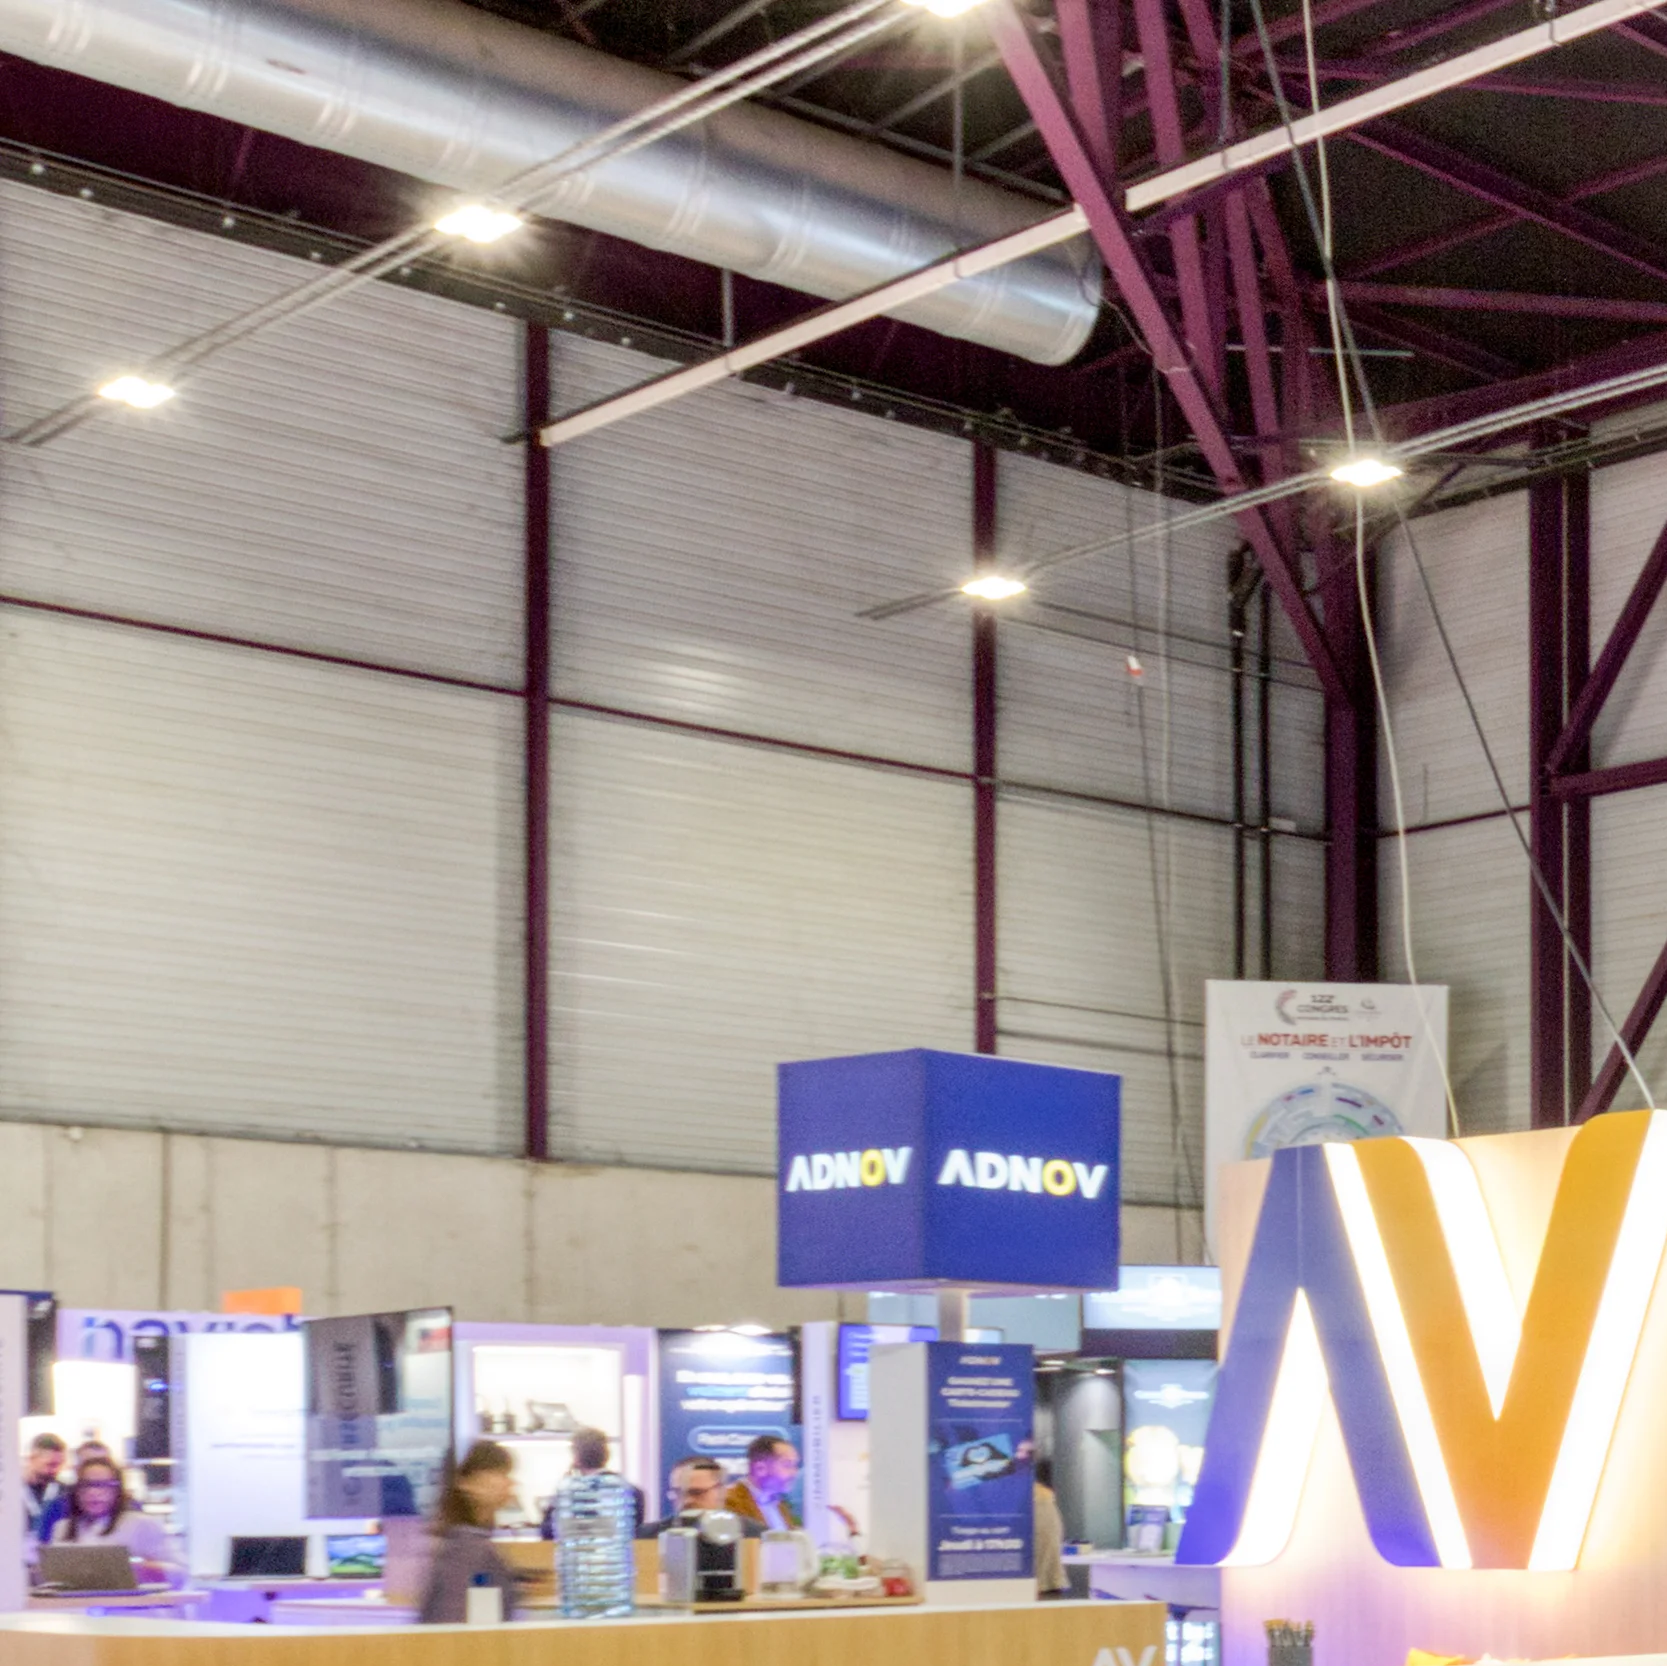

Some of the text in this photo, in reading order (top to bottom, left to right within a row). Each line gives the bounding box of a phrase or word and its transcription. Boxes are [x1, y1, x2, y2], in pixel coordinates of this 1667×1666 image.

[1257, 1033, 1329, 1047] NOTAIRE
[1348, 1031, 1412, 1049] L'IMPÔT
[785, 1146, 914, 1192] ADNOV
[937, 1148, 1109, 1199] ADNOV
